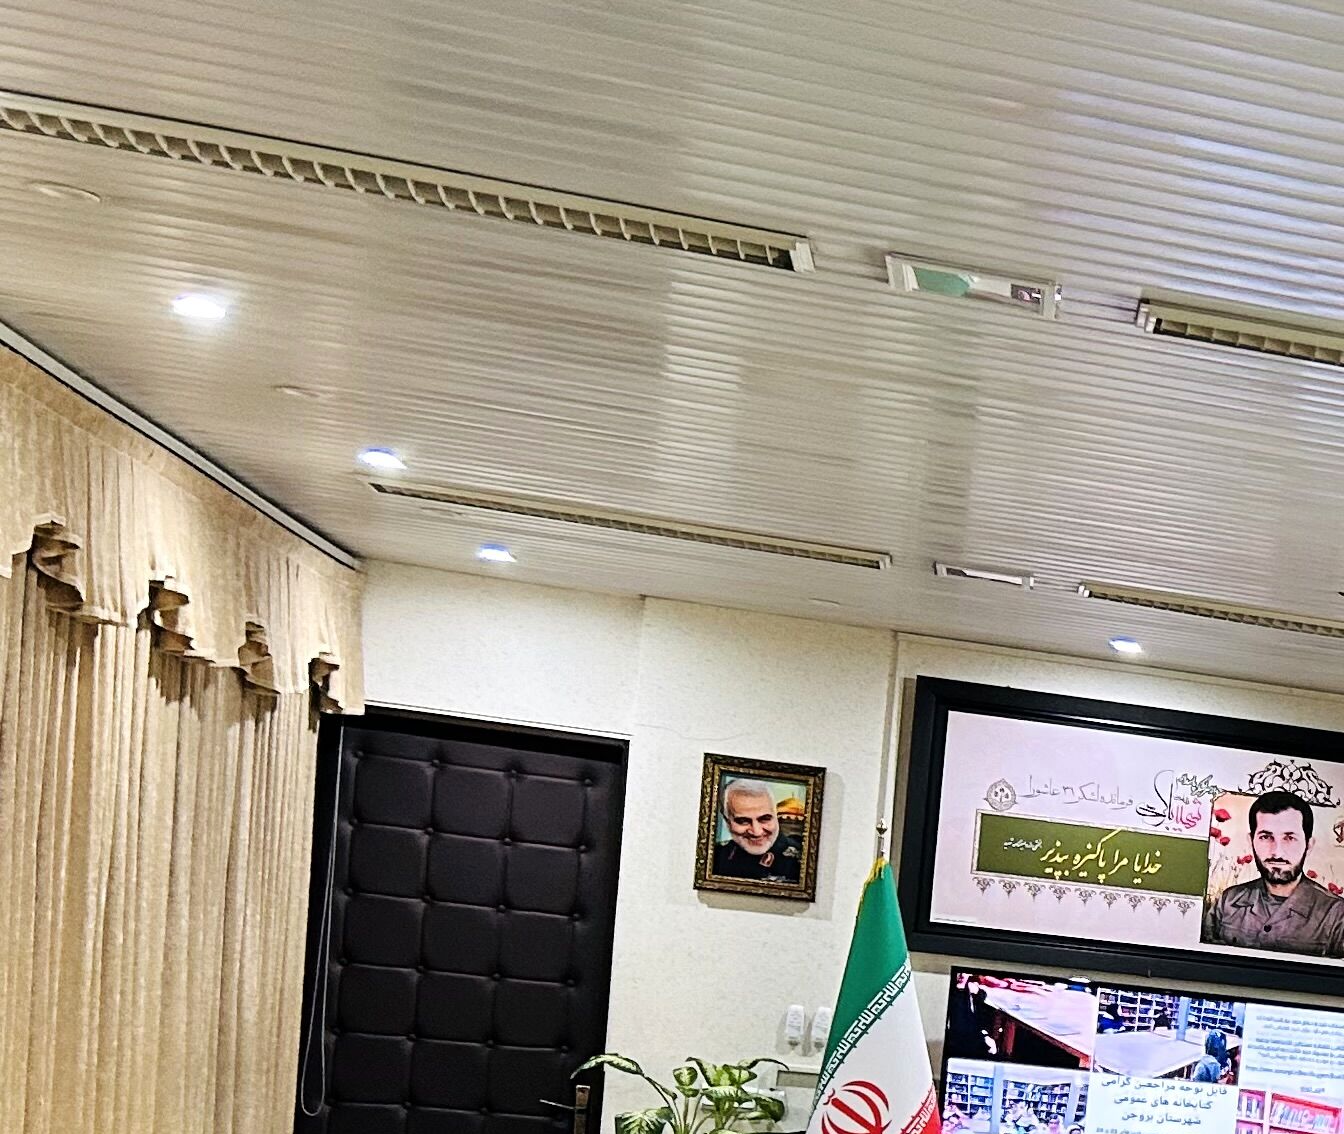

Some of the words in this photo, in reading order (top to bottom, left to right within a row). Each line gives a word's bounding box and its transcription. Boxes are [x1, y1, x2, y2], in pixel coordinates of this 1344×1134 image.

[1018, 774, 1060, 798] عاشورا
[1063, 782, 1100, 804] لشکر
[1100, 785, 1133, 810] فرمانده
[1040, 839, 1069, 881] بپذیر
[1072, 827, 1122, 884] پاکیزه
[1108, 849, 1129, 876] مرا
[1133, 850, 1162, 884] خدایا
[1101, 1076, 1132, 1088] گرامی
[1113, 1095, 1147, 1104] عمومی
[1150, 1096, 1169, 1108] های
[1172, 1098, 1214, 1110] کتابخانه
[1156, 1112, 1202, 1126] شهرستان
